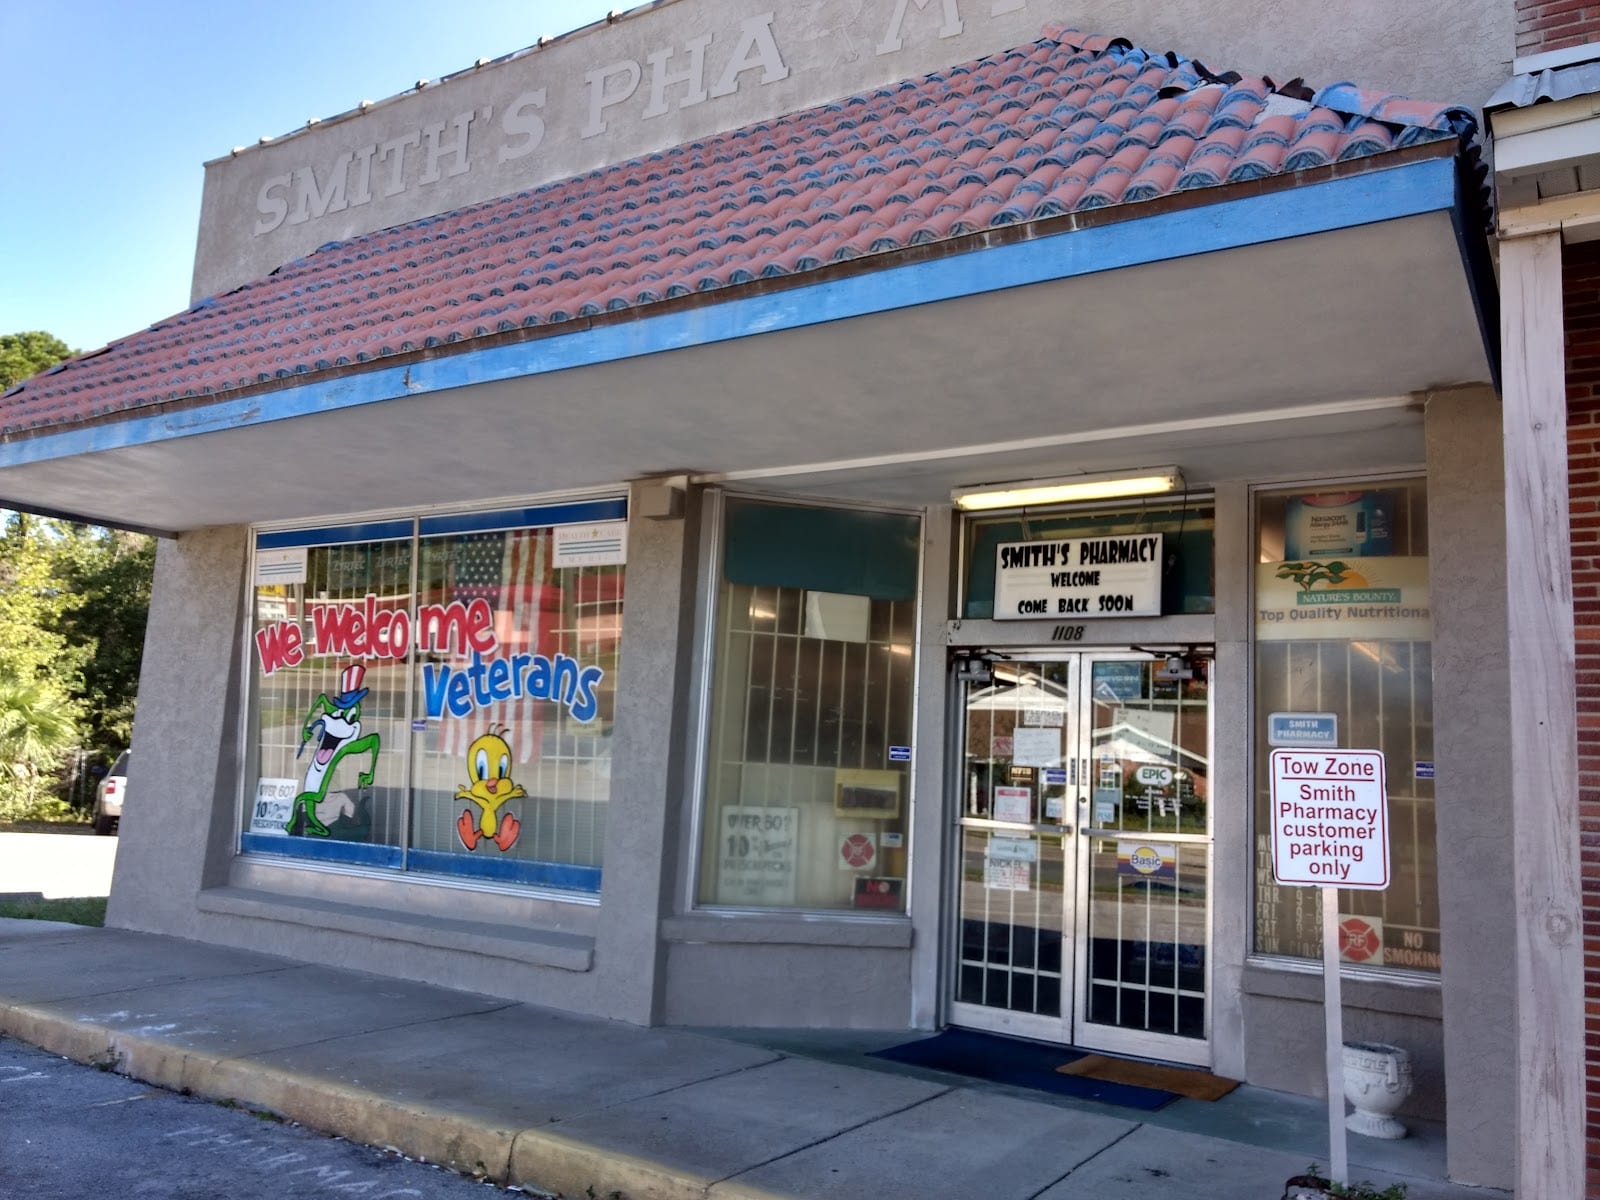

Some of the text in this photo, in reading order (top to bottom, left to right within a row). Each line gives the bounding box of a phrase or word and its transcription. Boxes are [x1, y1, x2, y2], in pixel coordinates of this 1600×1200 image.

[254, 88, 547, 237] SMITH'S
[1001, 537, 1158, 569] SMITH'S PHARMACY
[1051, 571, 1100, 587] WELCOME
[1018, 595, 1133, 614] COME BACK SOON
[1303, 591, 1394, 602] NATURE'S BOUNTY
[1259, 610, 1285, 622] Top
[1290, 608, 1341, 621] Quality
[1052, 626, 1084, 641] 1108
[423, 650, 604, 724] Veterans
[1289, 720, 1318, 729] SMITH
[1277, 730, 1331, 739] PHARMACY
[1142, 768, 1167, 780] EPIC
[1280, 757, 1374, 776] Tow Zone
[1300, 784, 1355, 802] Smith
[1280, 802, 1377, 824] Pharmacy
[1284, 823, 1376, 839] customer
[1290, 840, 1363, 861] parking
[1132, 855, 1160, 866] Basic
[1310, 861, 1350, 880] only
[1404, 931, 1424, 949] NO
